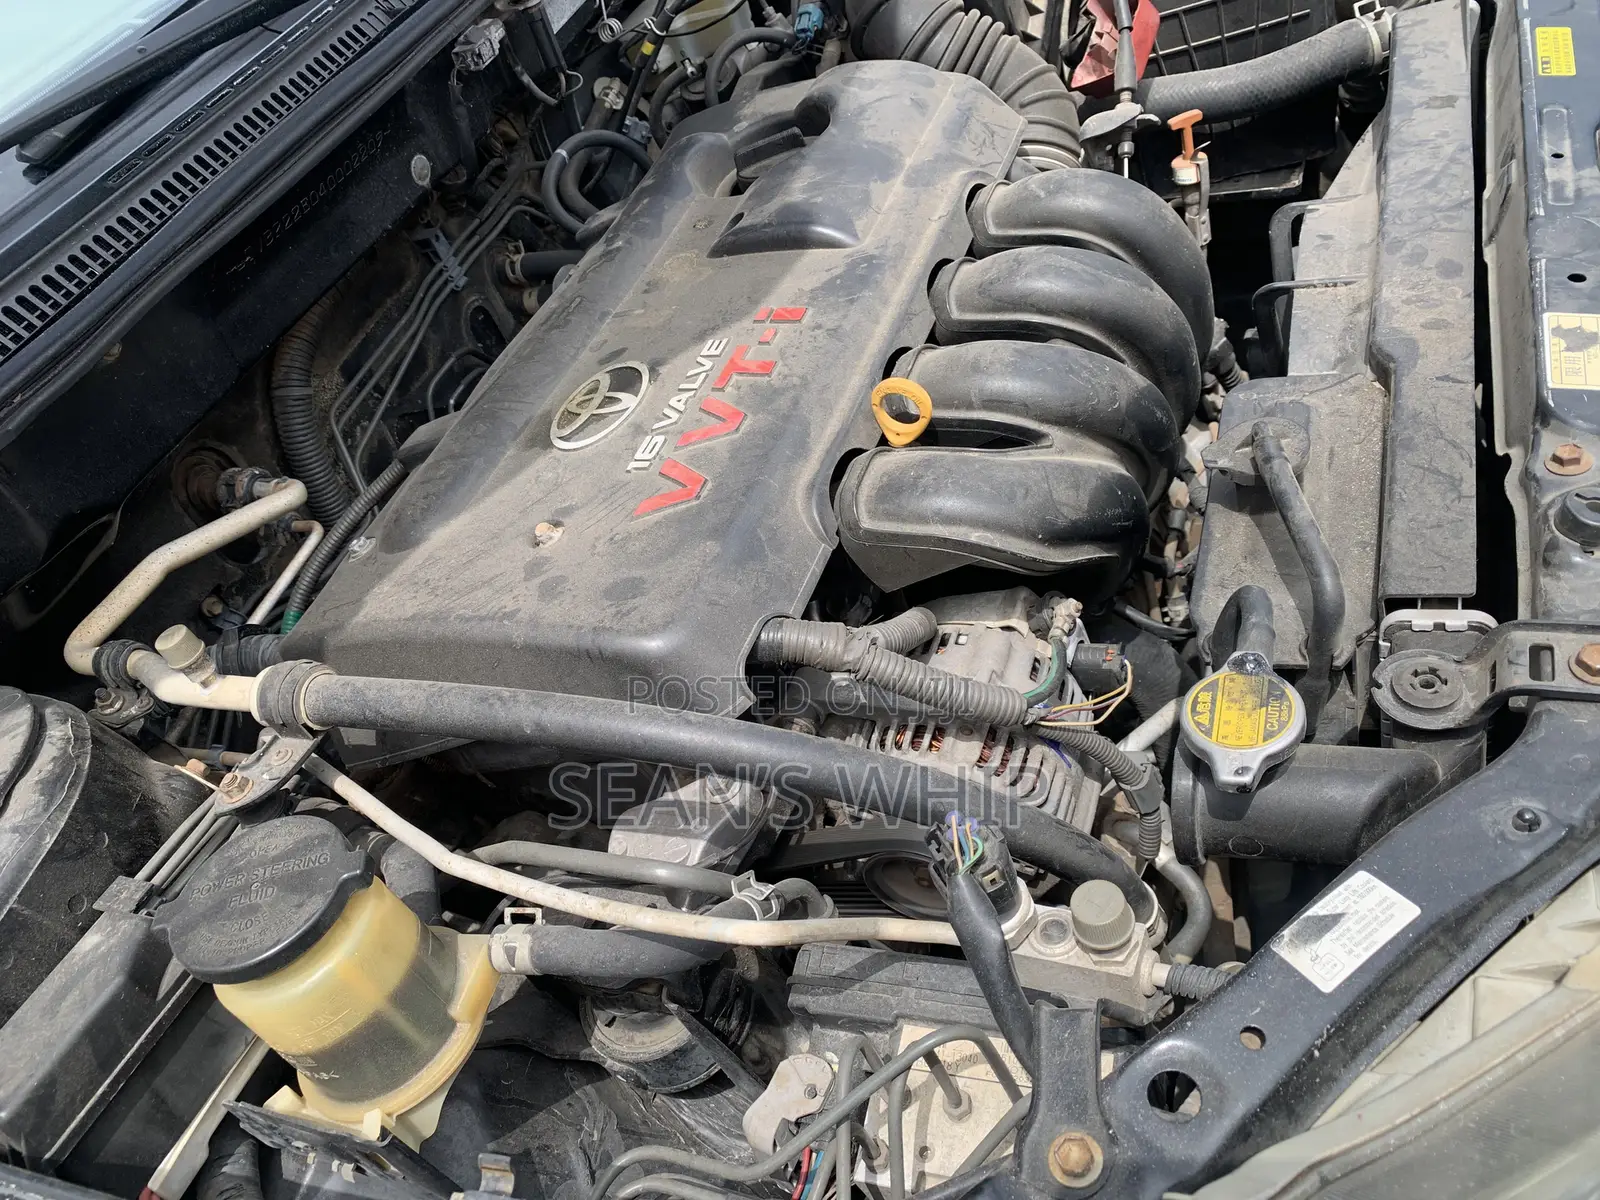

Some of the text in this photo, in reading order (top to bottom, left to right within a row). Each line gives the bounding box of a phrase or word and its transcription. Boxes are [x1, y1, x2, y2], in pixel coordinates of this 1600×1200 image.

[651, 337, 729, 432] VALVE
[1266, 691, 1282, 731] CAUTION
[189, 852, 331, 902] POWER STEERING
[228, 885, 277, 910] FLUID
[231, 912, 269, 934] CLOSE
